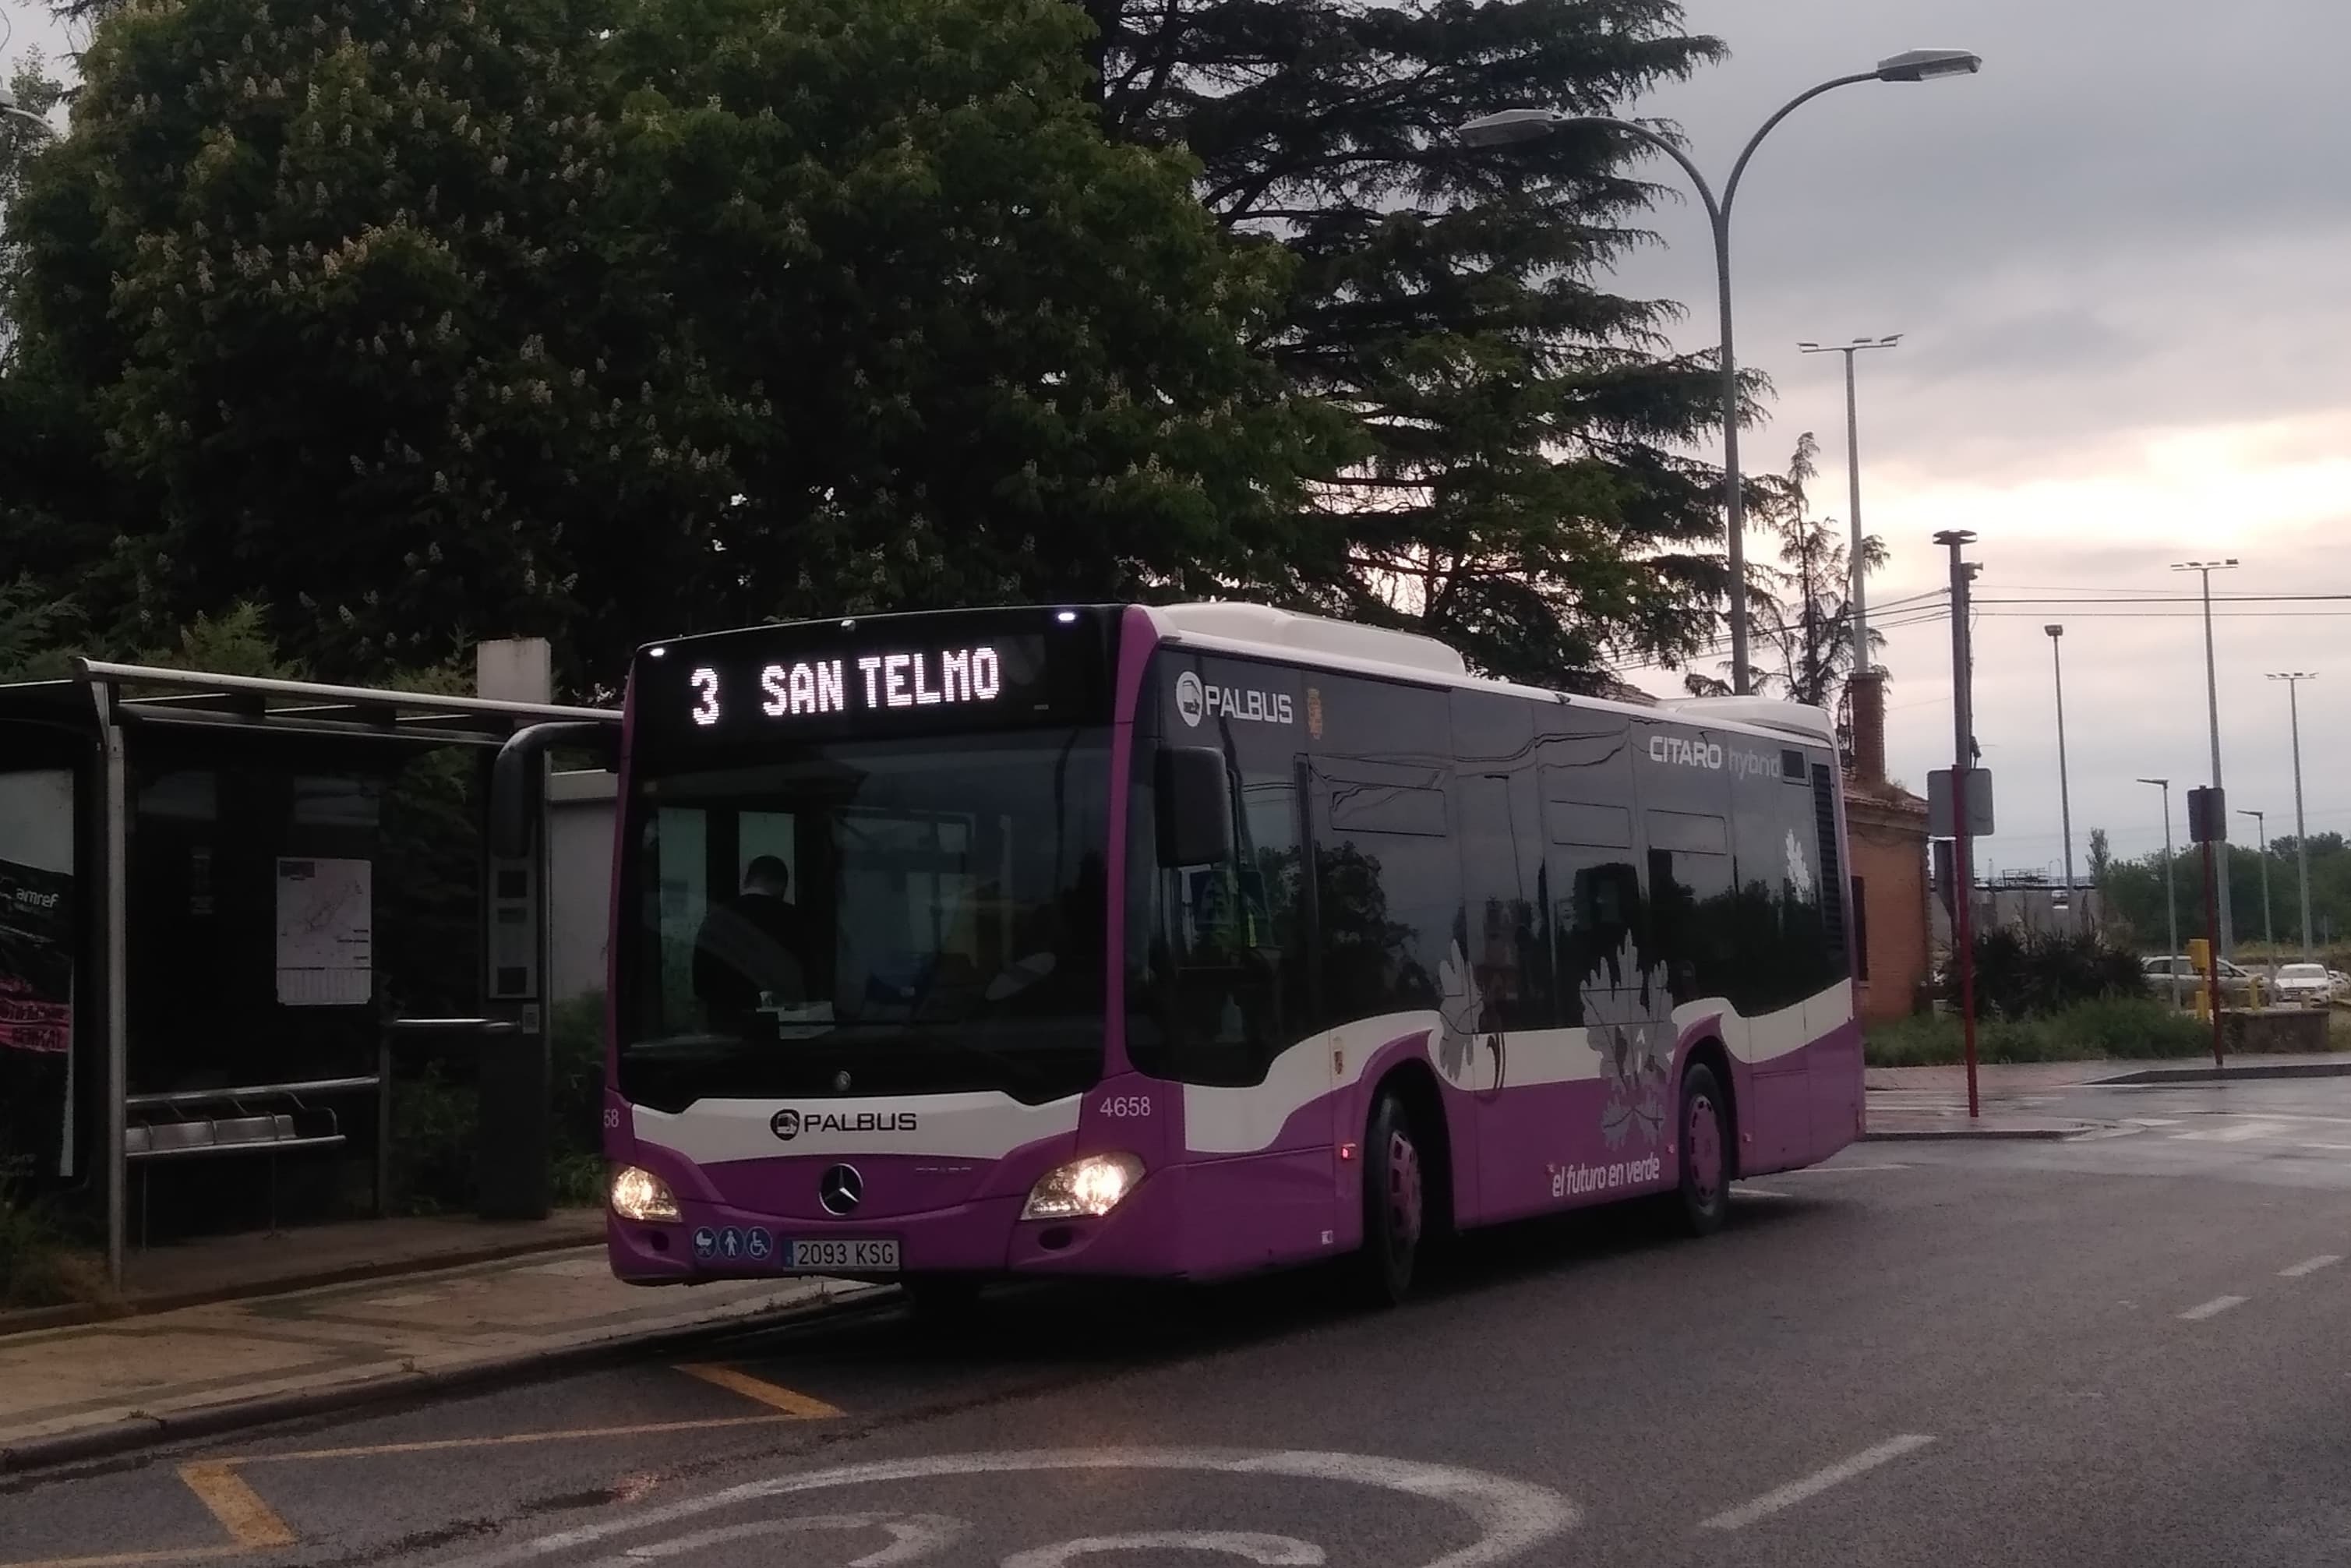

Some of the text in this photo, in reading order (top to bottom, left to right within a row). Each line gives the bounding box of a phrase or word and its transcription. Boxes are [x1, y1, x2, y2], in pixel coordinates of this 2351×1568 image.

[690, 646, 1001, 726] 3 SAN TELMO
[1204, 684, 1294, 724] PALBUS
[1649, 735, 1723, 770] CITARO
[16, 887, 60, 909] amref
[1099, 1096, 1151, 1118] 4658
[803, 1112, 918, 1133] PALBUS
[1552, 1151, 1661, 1198] el futuro en verde
[798, 1243, 847, 1265] 2093
[856, 1243, 894, 1264] KSG
